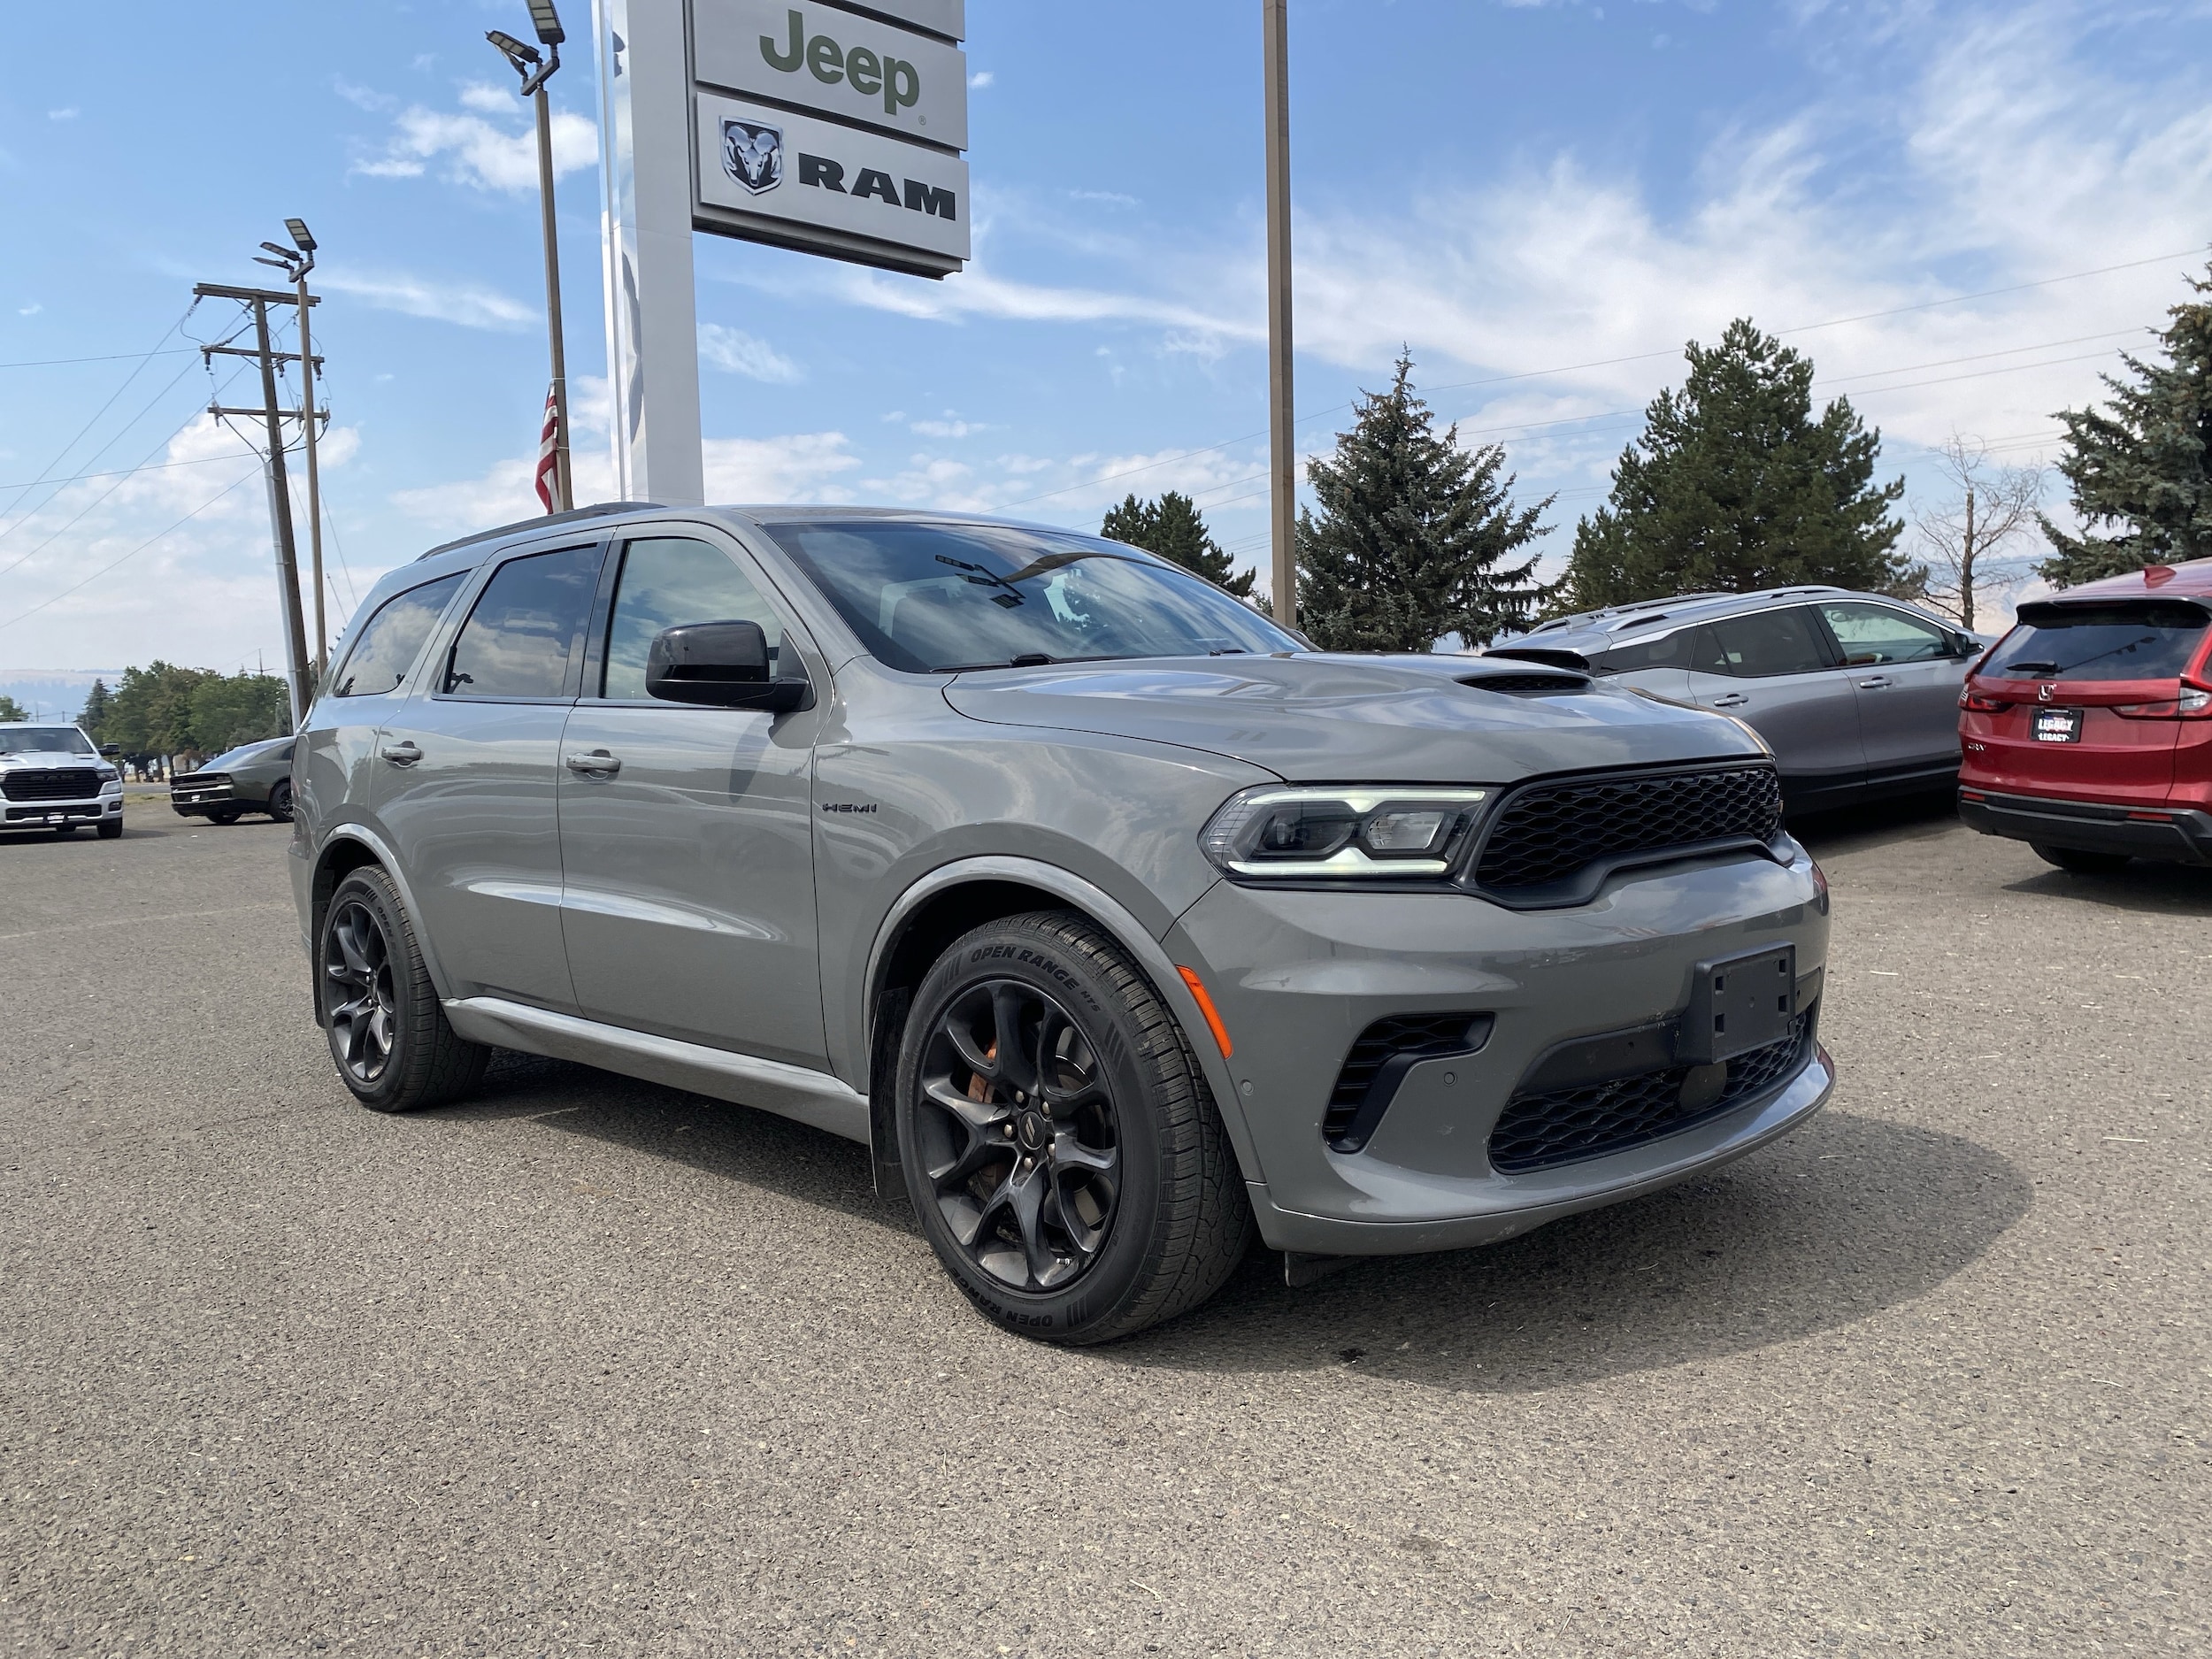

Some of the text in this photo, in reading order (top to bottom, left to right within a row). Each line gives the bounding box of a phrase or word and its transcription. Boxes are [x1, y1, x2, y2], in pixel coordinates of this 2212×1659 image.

[759, 9, 919, 115] Jeep
[798, 152, 956, 221] RAM
[2038, 718, 2074, 731] LEGACY
[2039, 733, 2069, 742] LEGACY
[822, 803, 877, 812] HEMI
[971, 945, 1102, 1012] OPEN RANGE HTS
[950, 1266, 1053, 1327] OPEN RANGE
